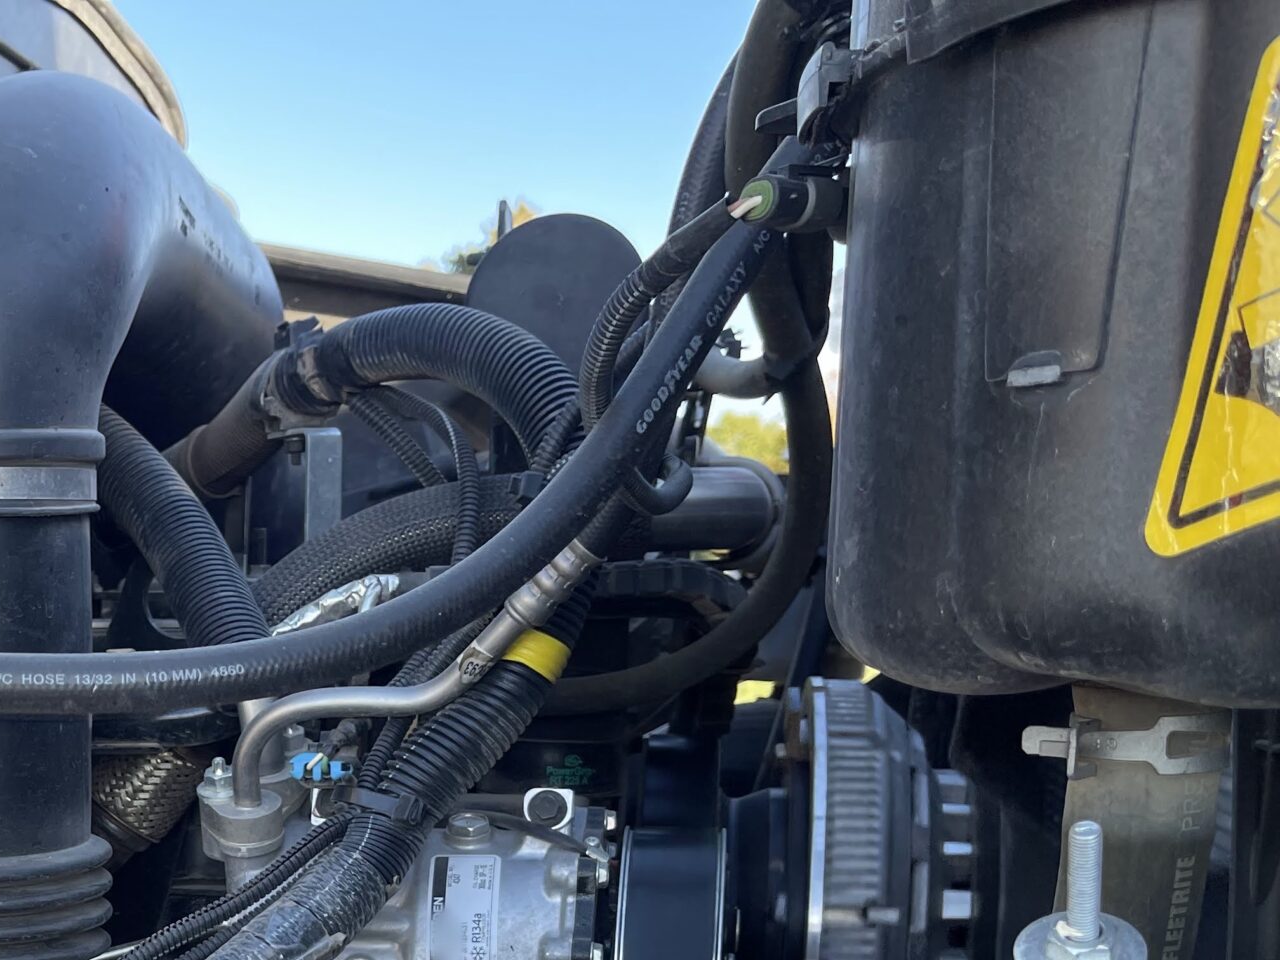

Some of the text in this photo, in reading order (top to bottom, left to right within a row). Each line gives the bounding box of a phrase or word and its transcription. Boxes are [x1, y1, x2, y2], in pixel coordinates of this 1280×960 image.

[636, 335, 704, 434] GOODYEAR
[22, 673, 65, 686] HOSE
[74, 672, 113, 686] 13/32
[121, 672, 137, 685] IN
[145, 670, 171, 687] (10
[175, 667, 203, 684] MM)
[210, 663, 245, 678] 4860
[471, 913, 482, 943] R134a
